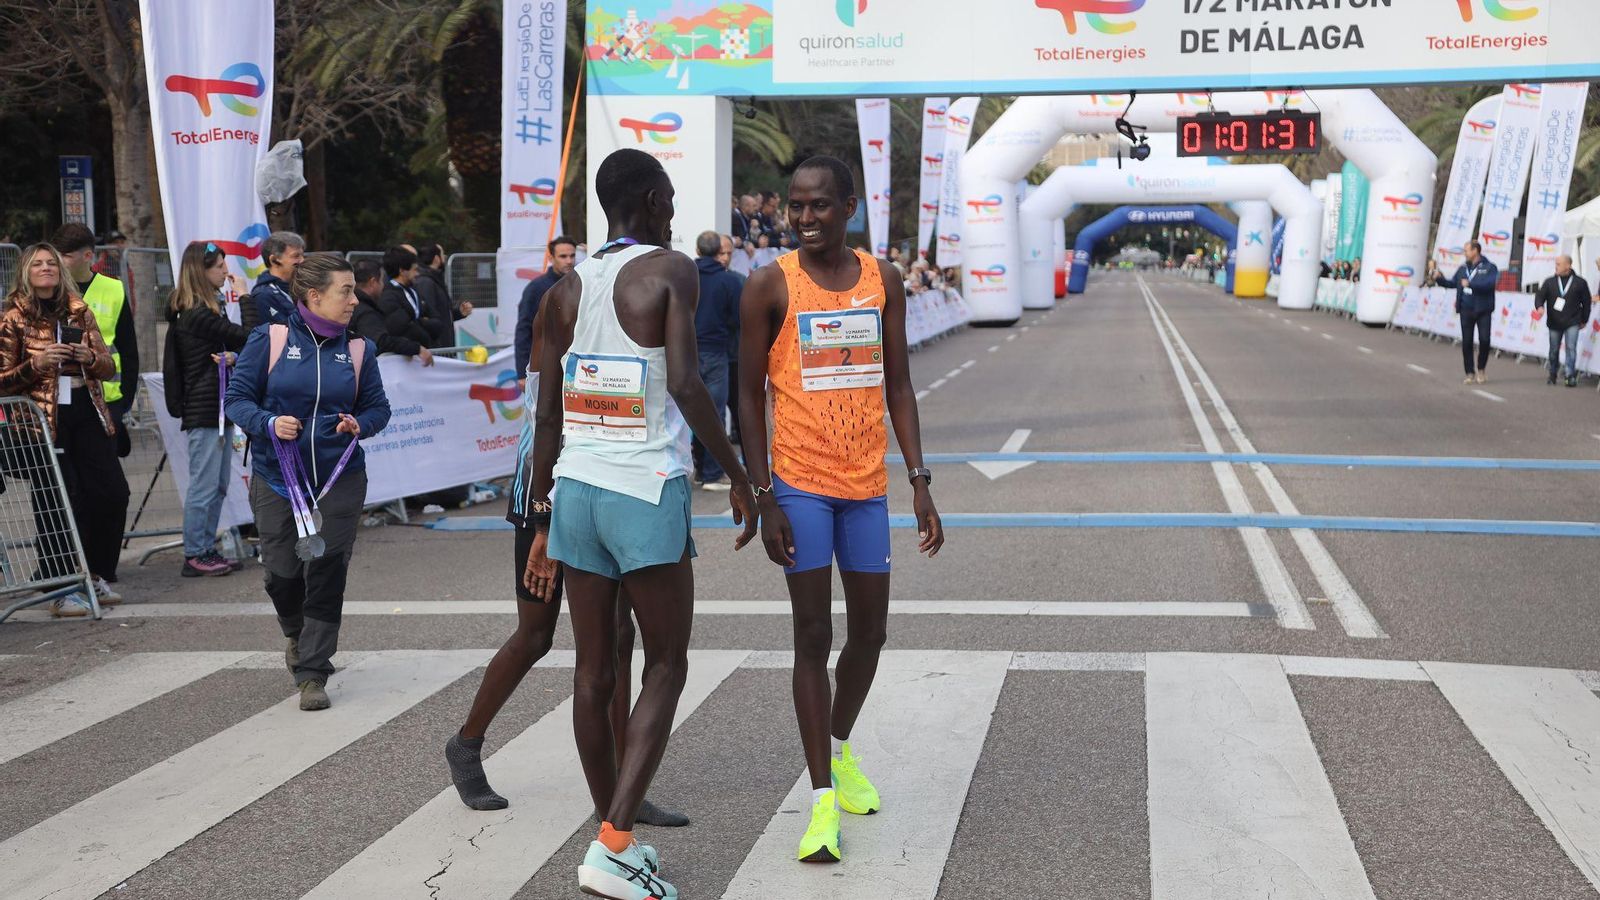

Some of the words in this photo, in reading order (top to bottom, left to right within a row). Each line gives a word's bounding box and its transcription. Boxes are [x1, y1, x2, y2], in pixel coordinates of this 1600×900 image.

[1180, 28, 1219, 54] DE
[1229, 21, 1365, 52] MÁLAGA
[1426, 33, 1550, 52] TotalEnergies
[533, 1, 555, 112] LasCarreras
[861, 57, 896, 67] Partner
[1034, 45, 1146, 63] TotalEnergies
[1183, 119, 1316, 153] 01:01:31
[1147, 210, 1196, 222] HYUNDAI
[840, 347, 853, 366] 2
[584, 399, 619, 411] MOSIN
[400, 423, 413, 434] que
[598, 414, 605, 426] 1
